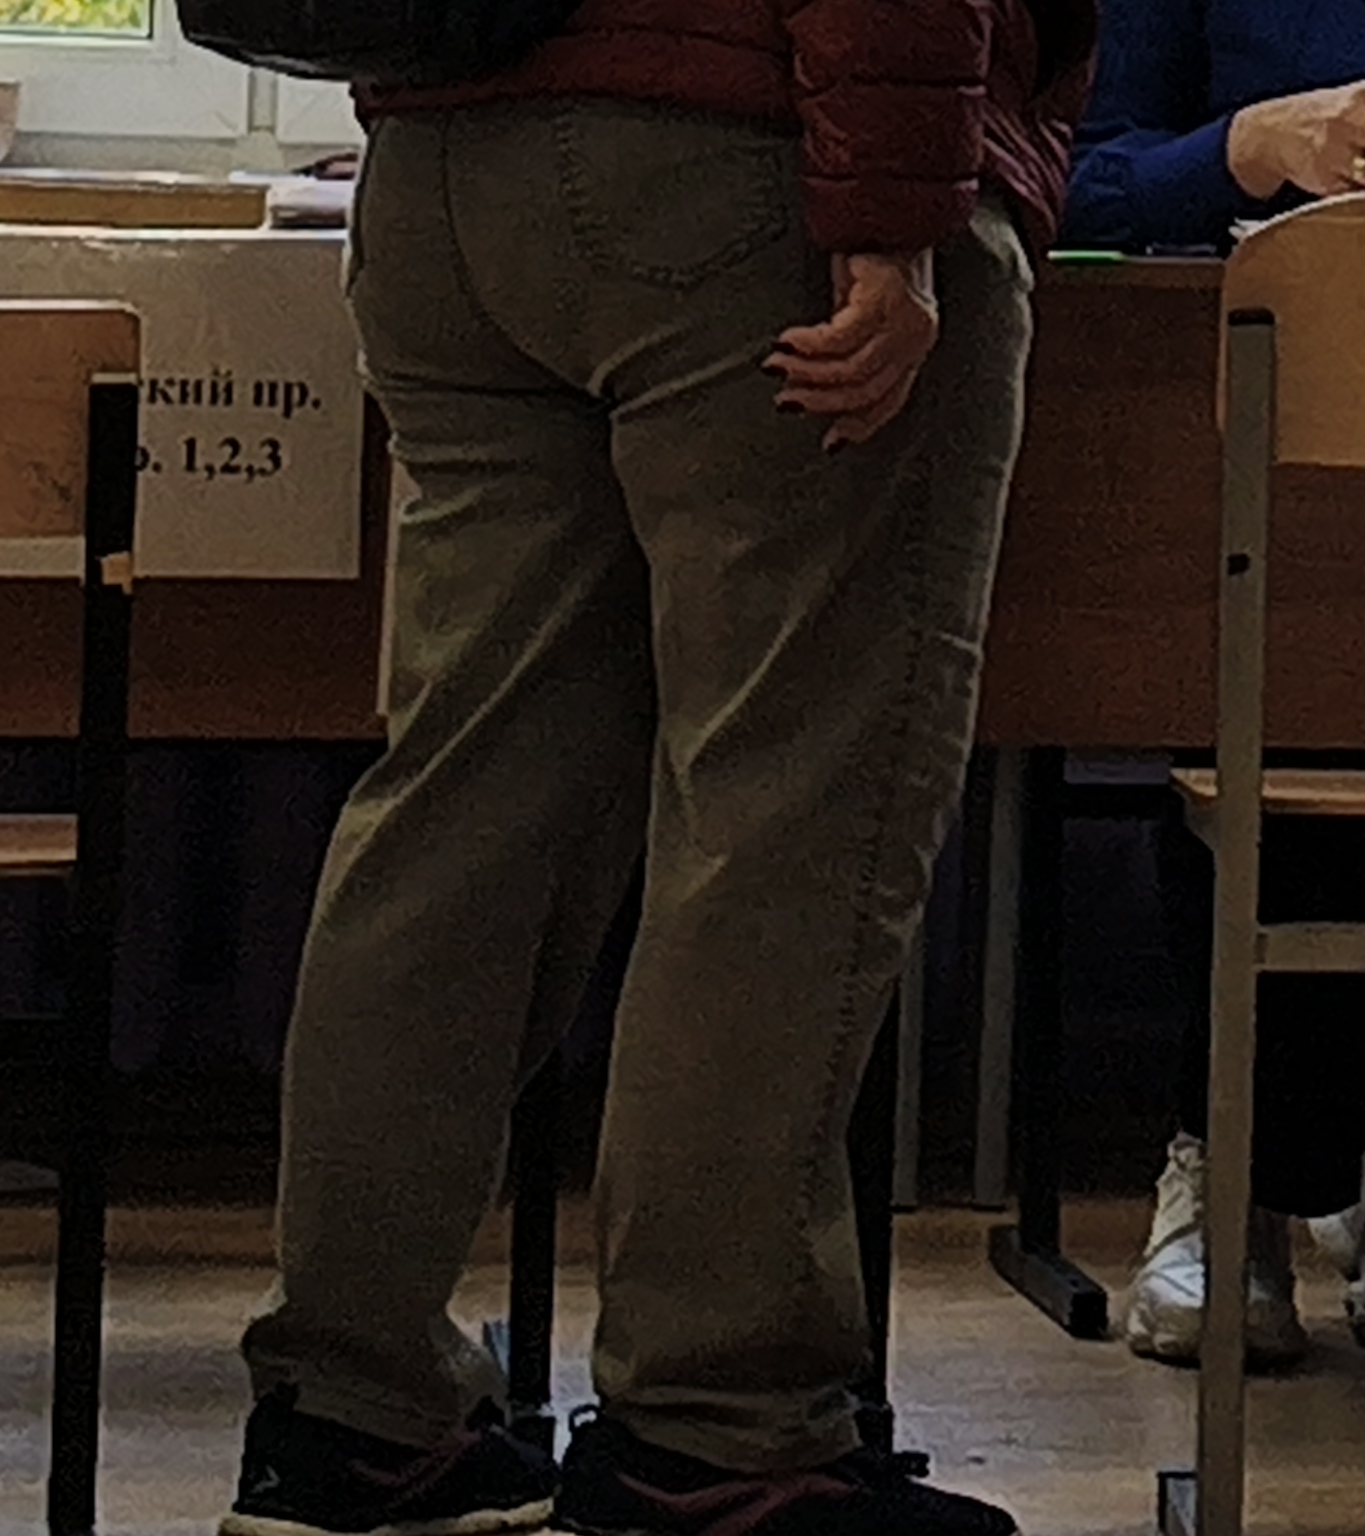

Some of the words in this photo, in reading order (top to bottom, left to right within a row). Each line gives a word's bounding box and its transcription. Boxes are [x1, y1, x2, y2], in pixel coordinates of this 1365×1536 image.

[139, 368, 235, 407] кий
[252, 379, 322, 419] пр.
[182, 437, 283, 482] 1,2,3
